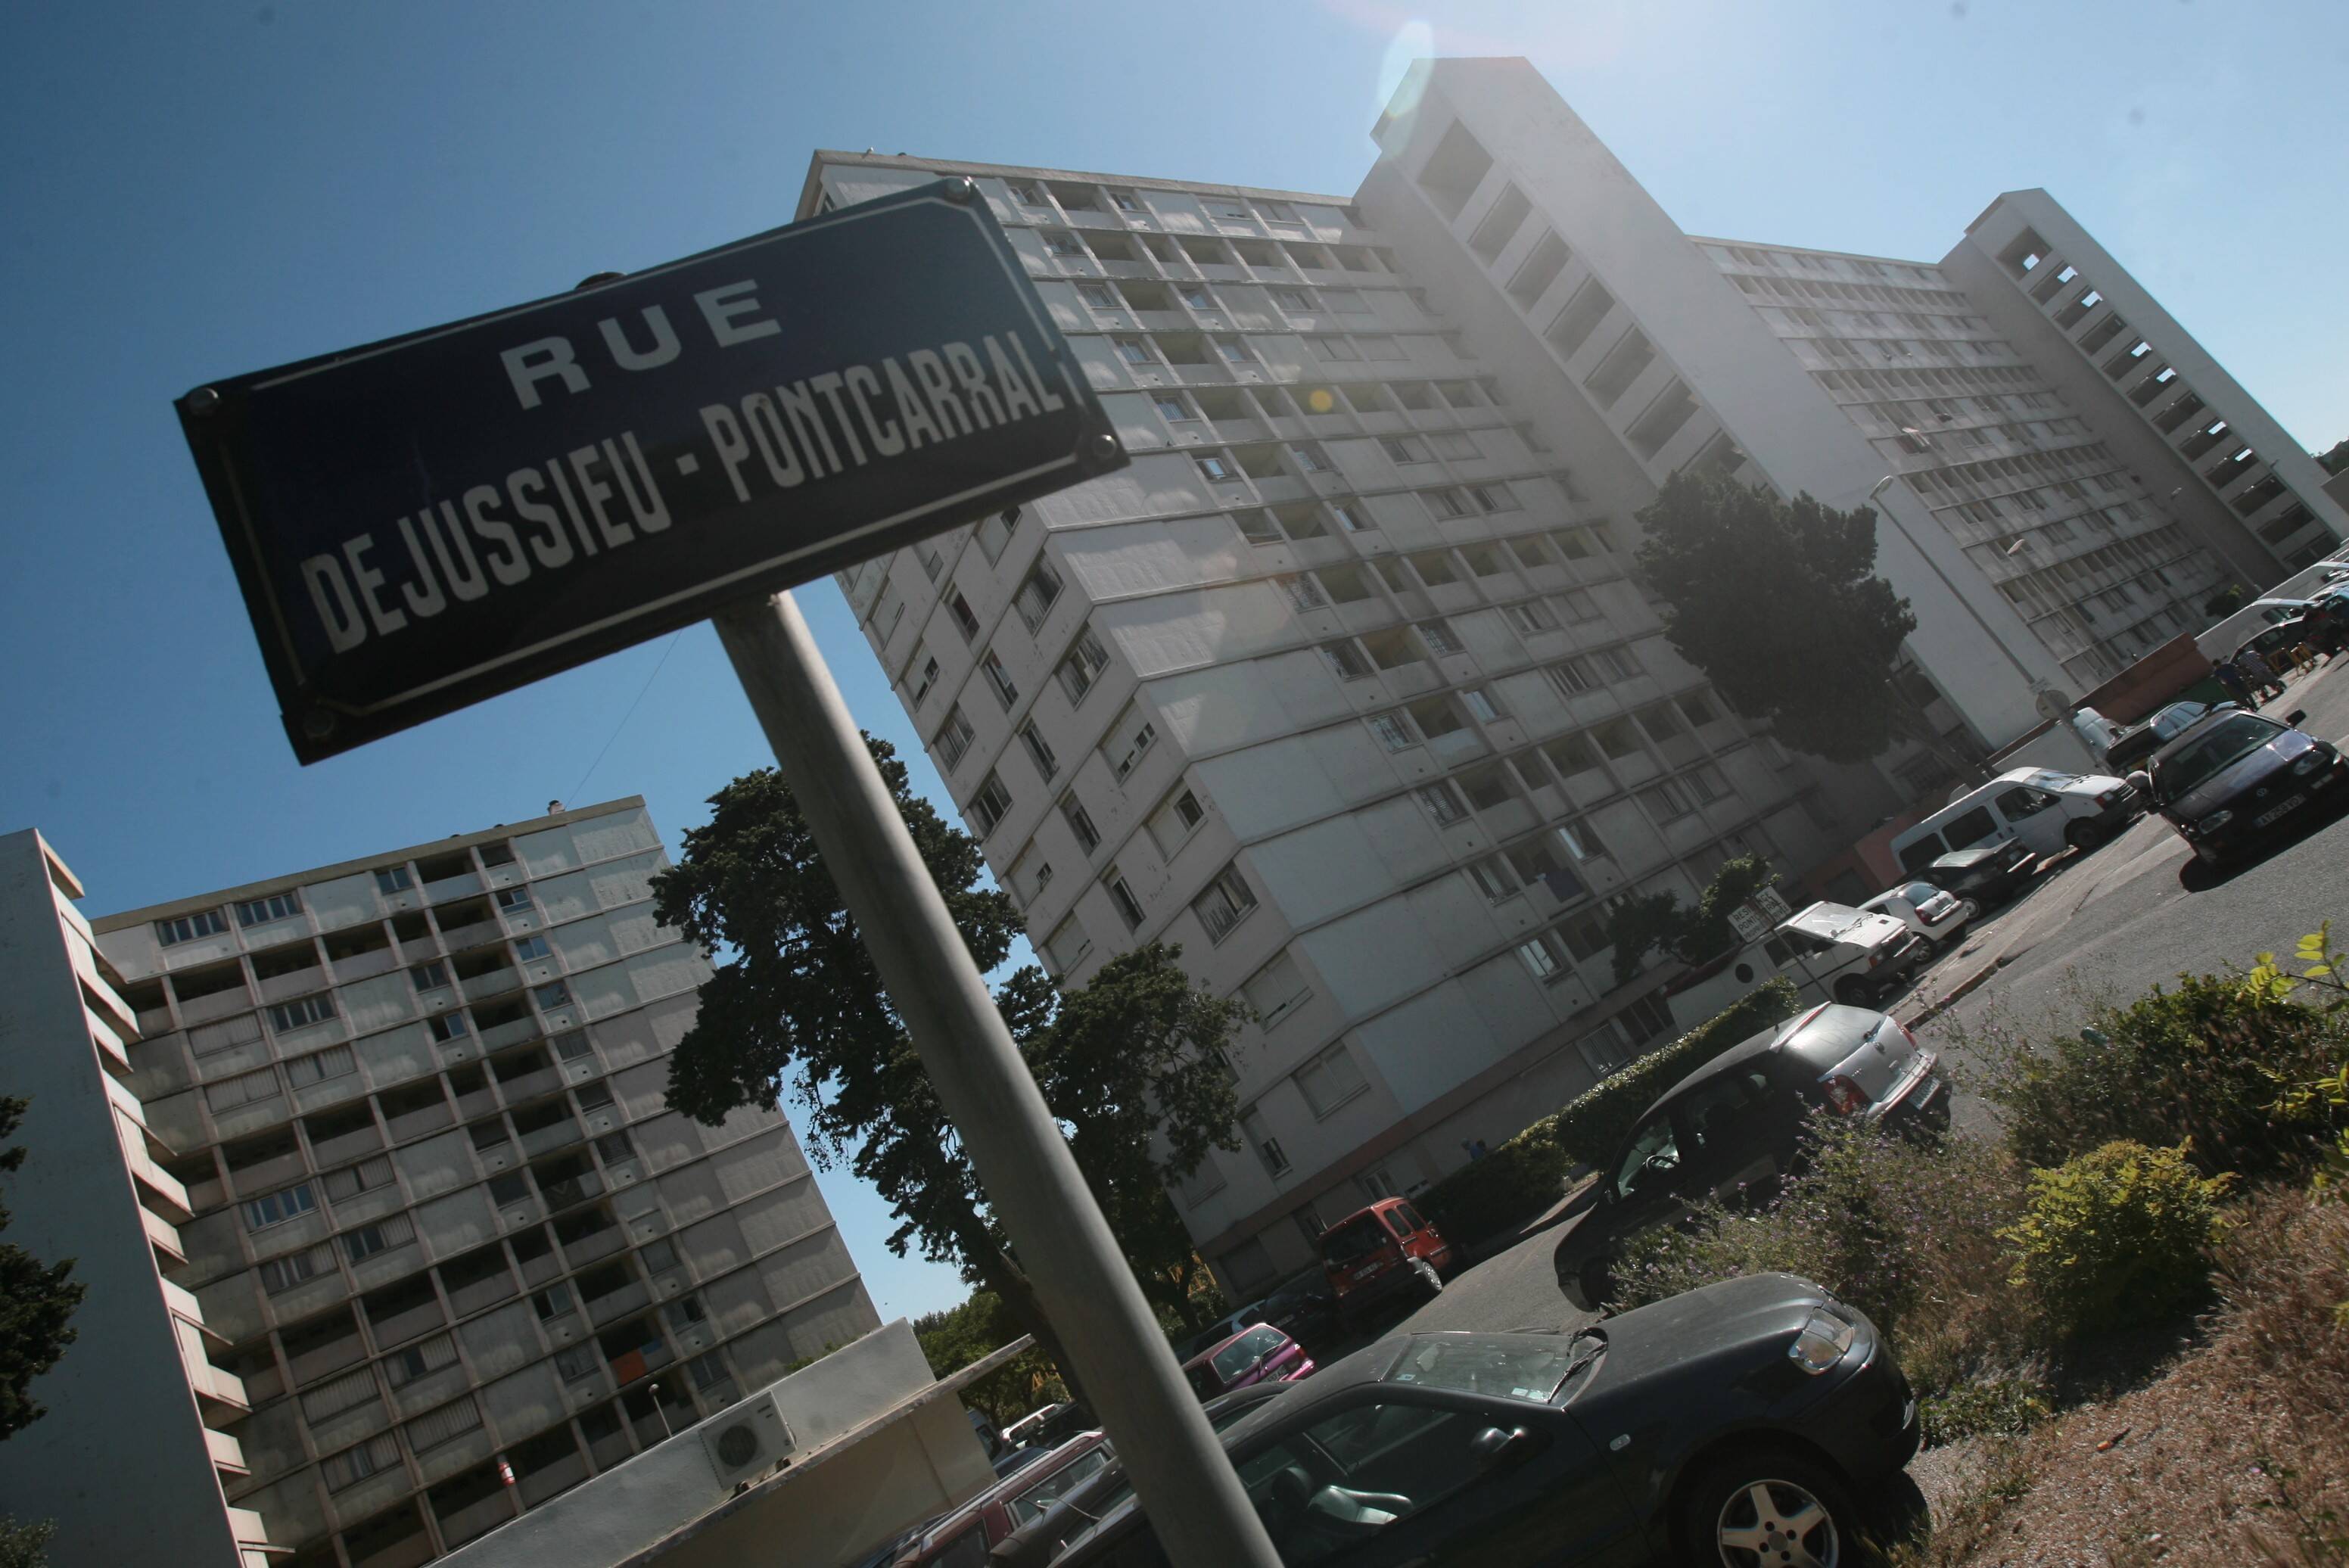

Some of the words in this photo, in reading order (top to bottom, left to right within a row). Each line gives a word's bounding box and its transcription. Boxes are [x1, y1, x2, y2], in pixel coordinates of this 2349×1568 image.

[500, 278, 782, 409] RUE
[699, 330, 1066, 502] PONTCARRAL
[1732, 892, 1771, 922] RESINCE
